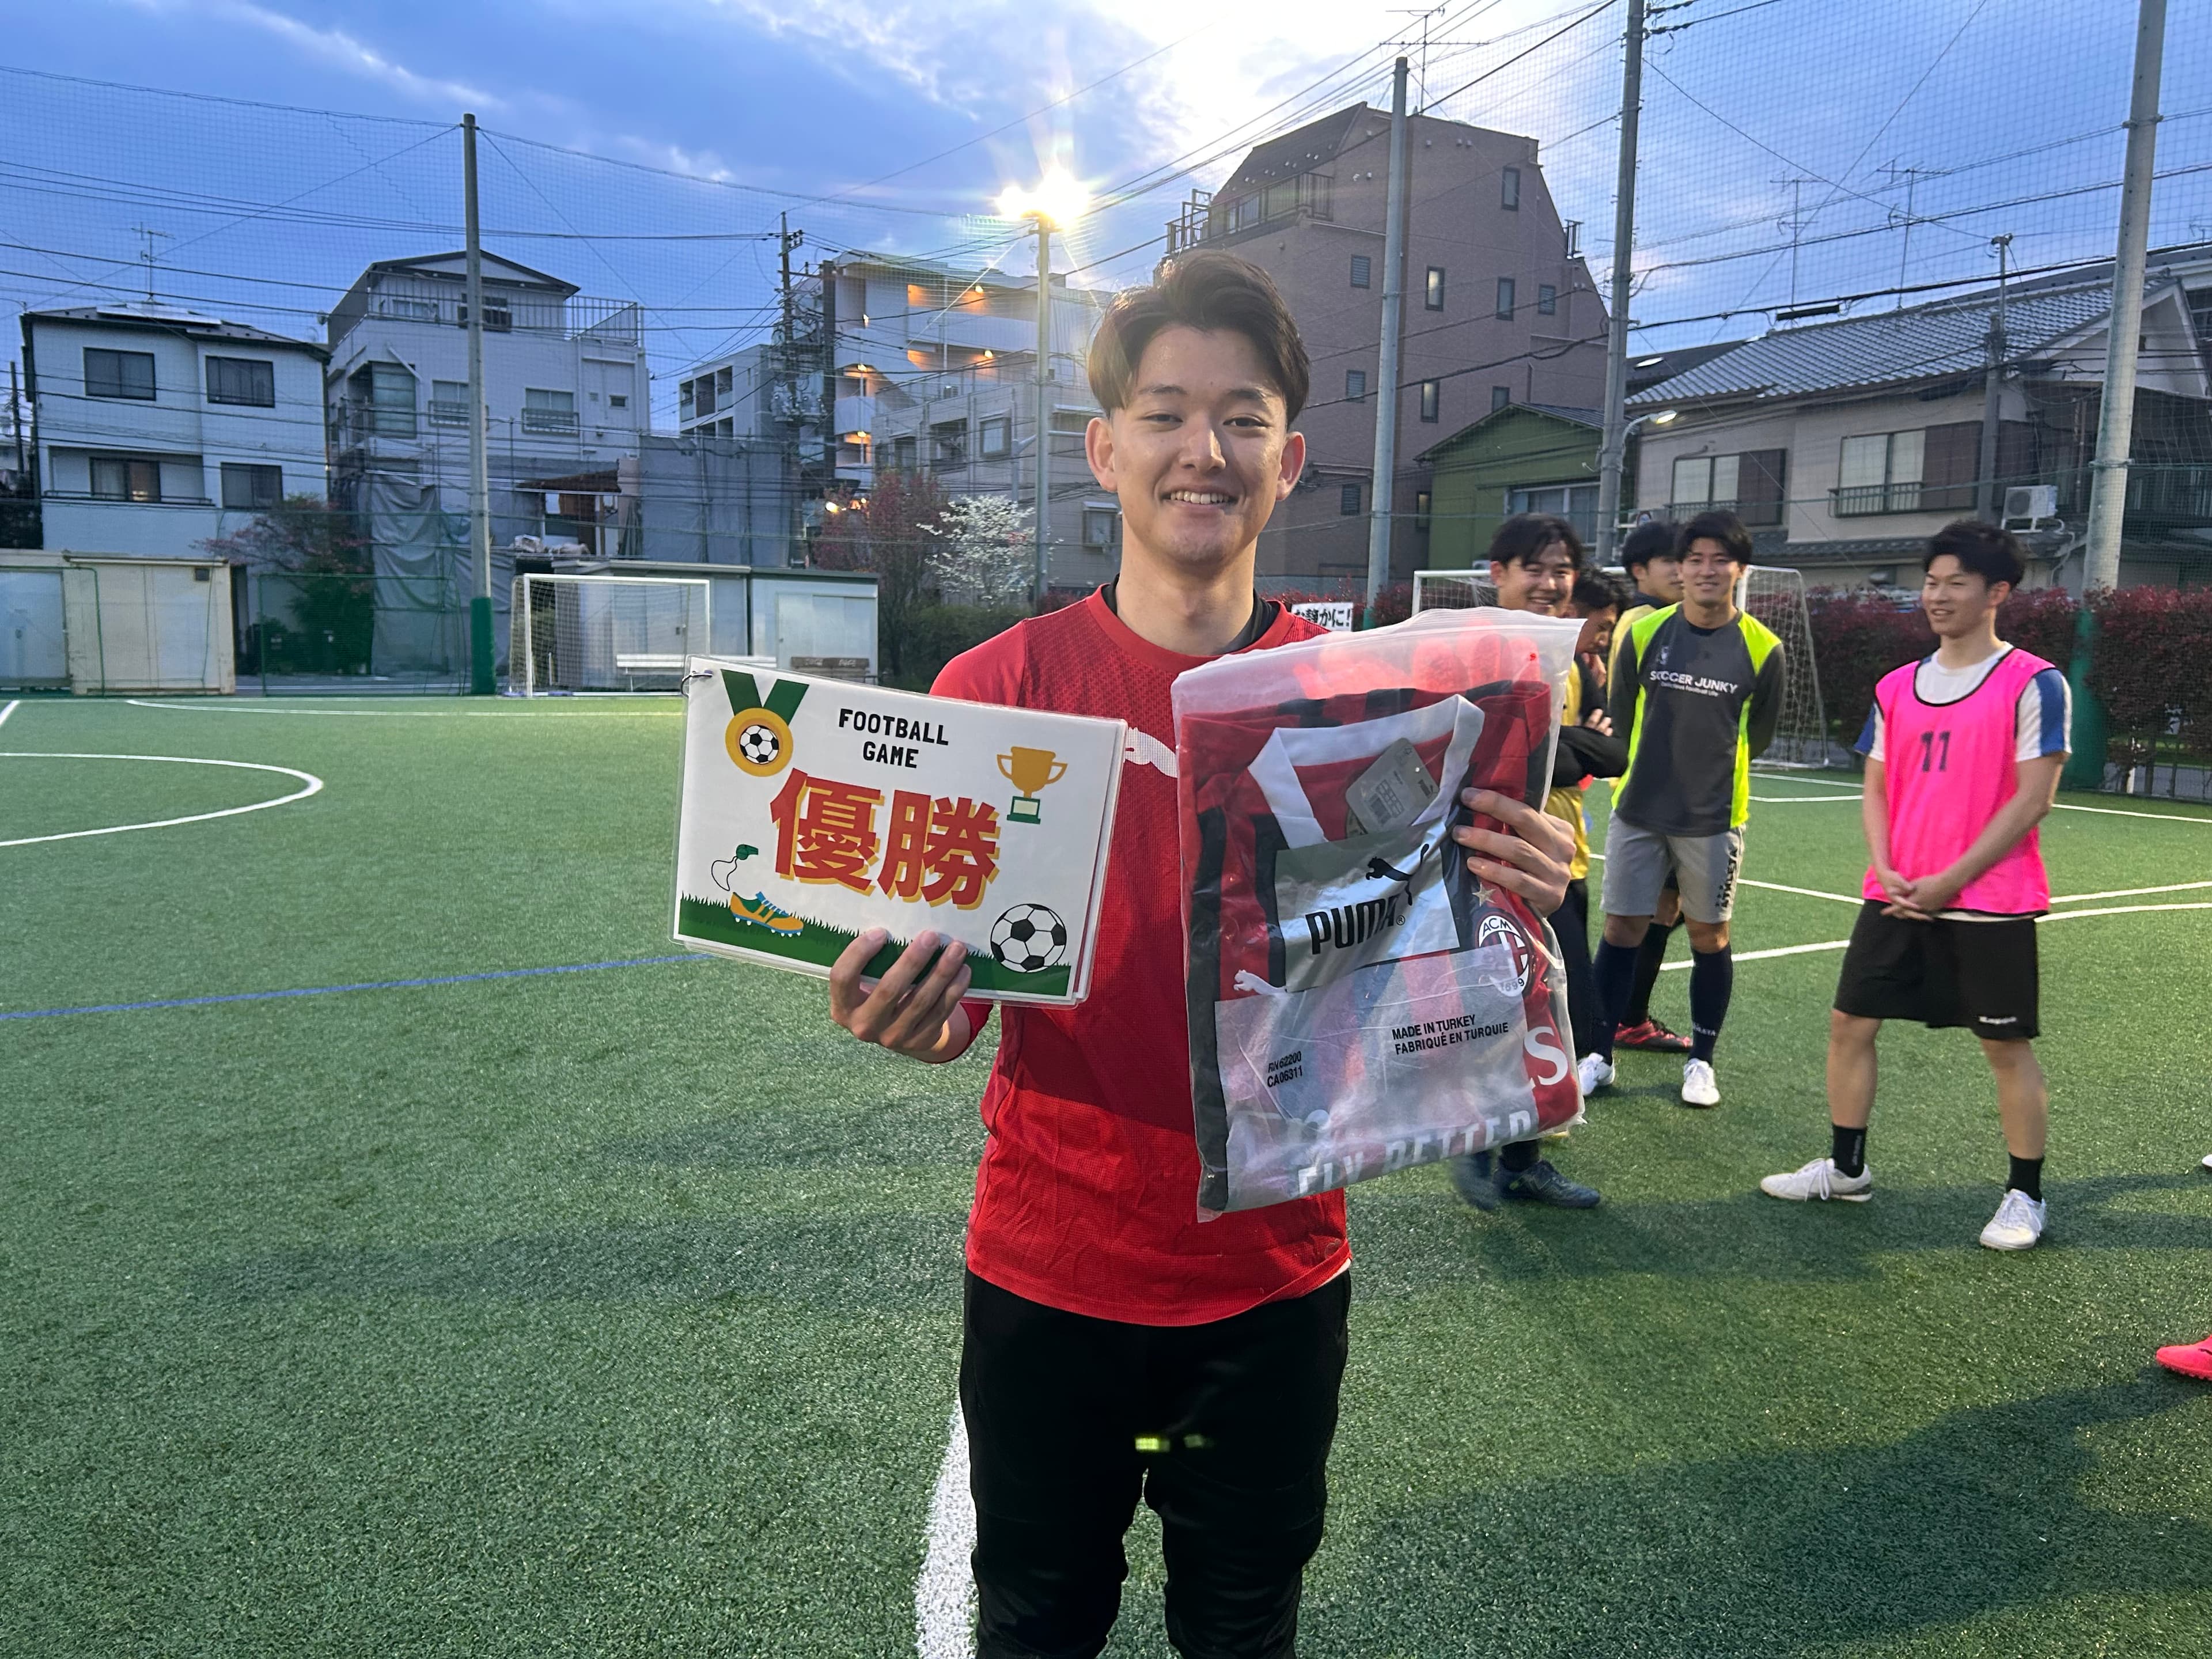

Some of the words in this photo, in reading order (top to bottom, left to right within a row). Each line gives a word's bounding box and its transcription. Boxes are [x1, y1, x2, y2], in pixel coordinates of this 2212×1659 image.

[1649, 670, 1694, 685] SOCCER
[1694, 677, 1738, 694] JUNKY
[838, 707, 949, 747] FOOTBALL
[862, 741, 919, 769] GAME
[1921, 731, 1951, 772] 11
[770, 767, 1002, 911] 優勝
[1305, 893, 1402, 956] PUMA
[1482, 918, 1513, 937] ACM
[1392, 1024, 1422, 1040] MADE
[1423, 1022, 1435, 1035] IN
[1436, 1014, 1476, 1032] TURKEY
[1395, 1032, 1448, 1055] FABRIQUÉ
[1449, 1032, 1463, 1044] EN
[1464, 1022, 1509, 1041] TURQUIE
[1267, 1065, 1303, 1088] CA06311
